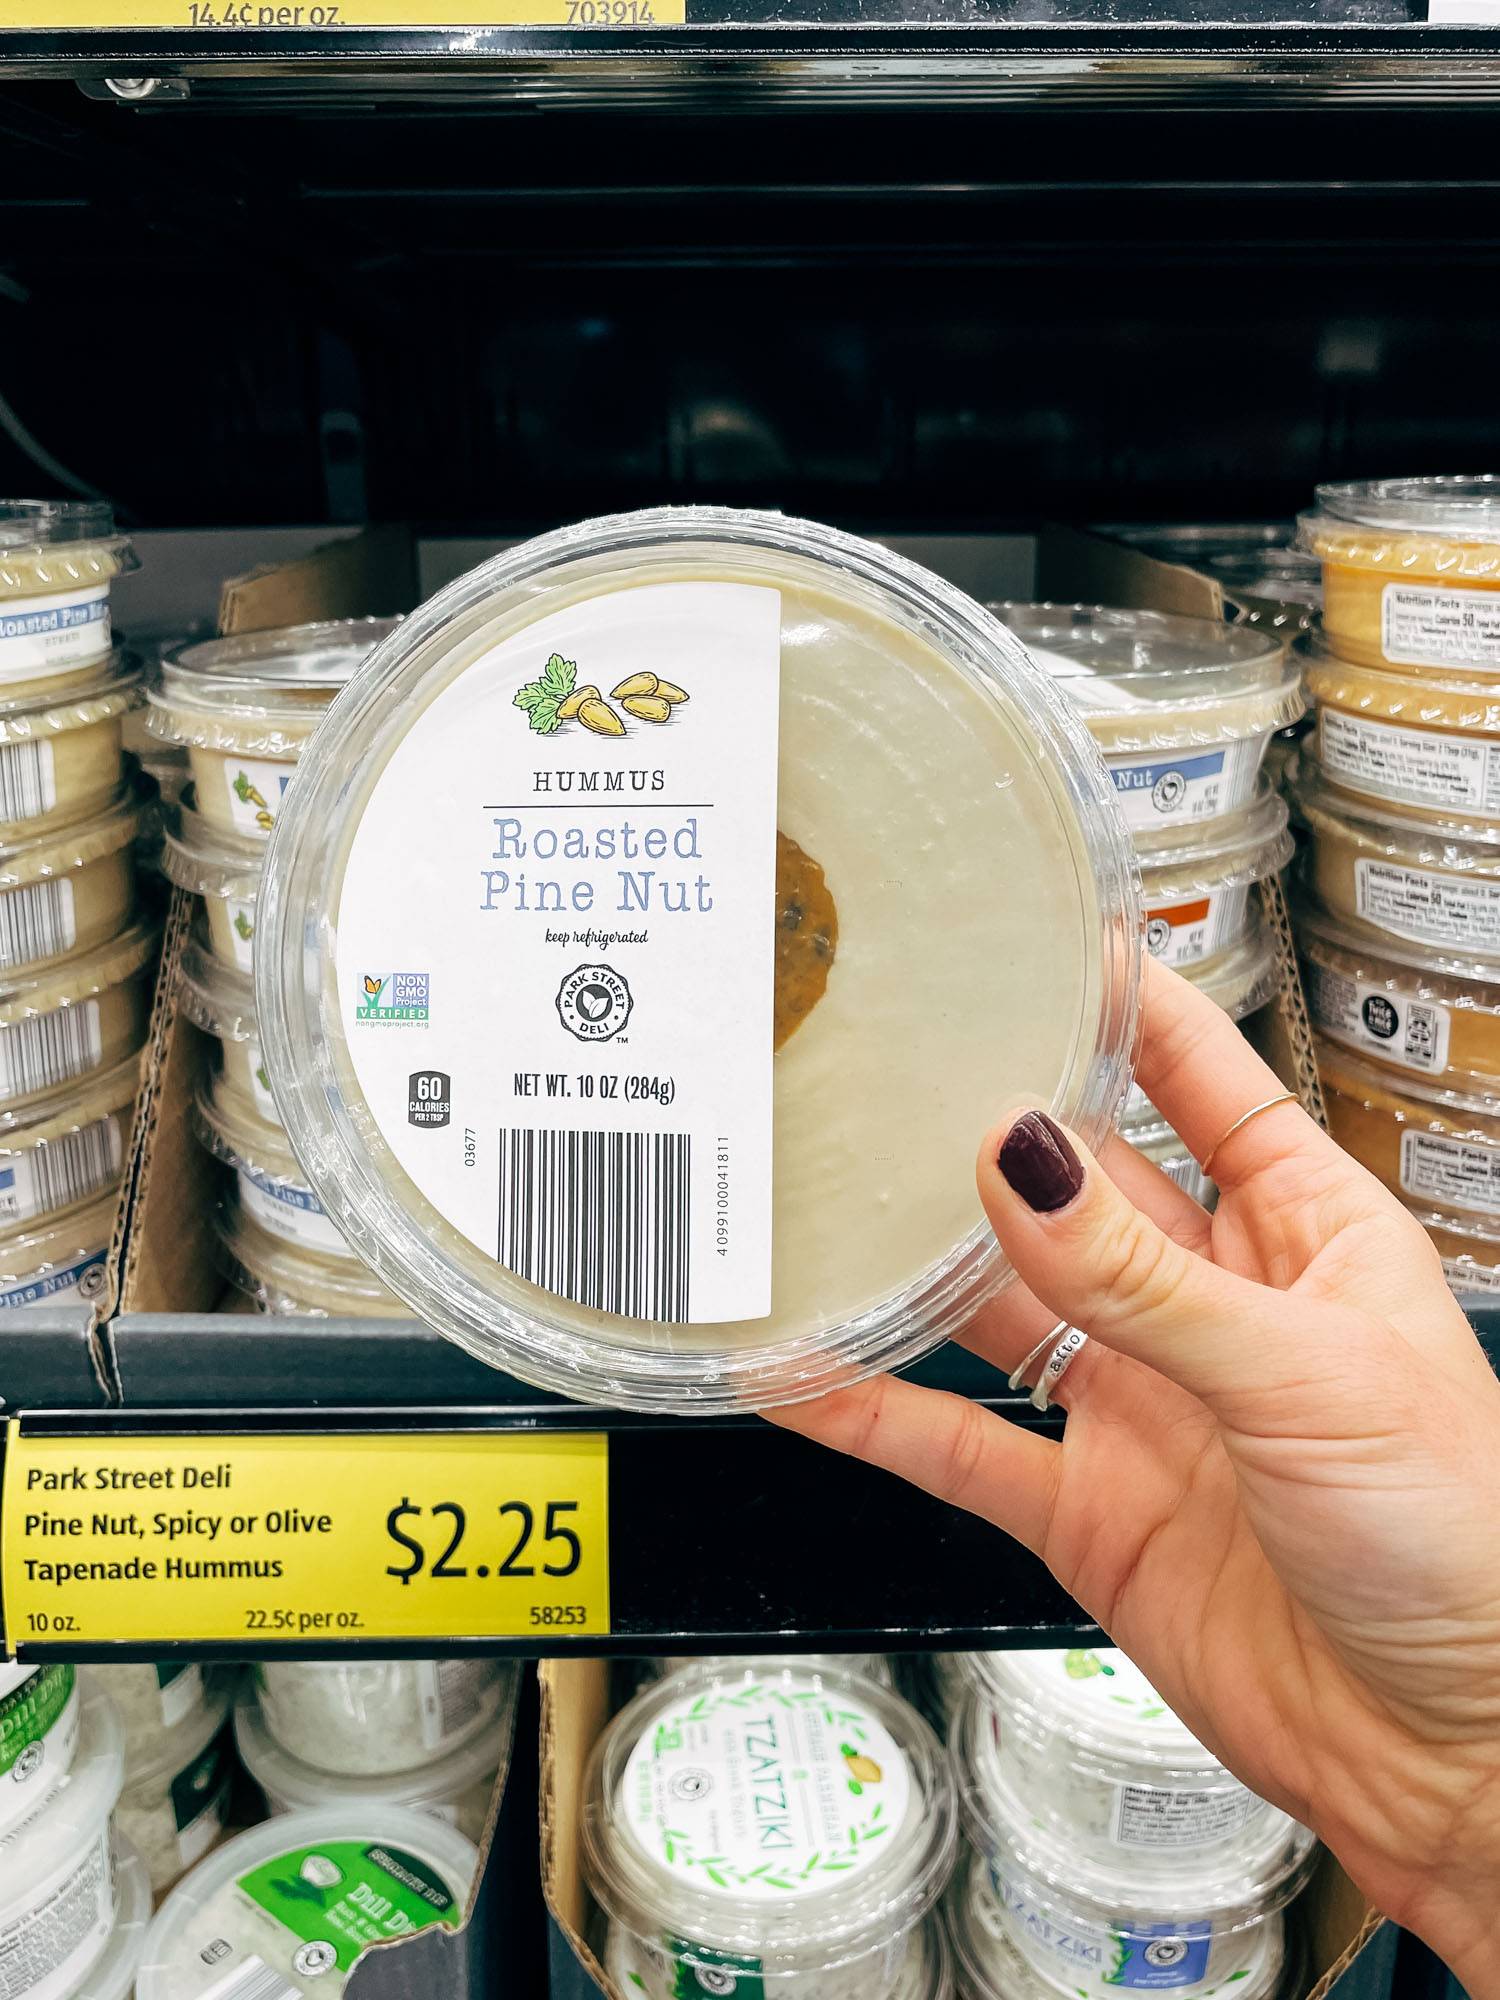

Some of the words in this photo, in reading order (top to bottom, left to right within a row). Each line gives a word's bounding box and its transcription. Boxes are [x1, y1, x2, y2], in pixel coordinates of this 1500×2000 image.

[188, 2, 253, 26] 14.4¢
[258, 6, 304, 26] per
[309, 6, 346, 25] oz.
[565, 0, 655, 25] 703914
[532, 769, 665, 792] HUMMUS
[1117, 769, 1153, 789] Nut
[492, 817, 703, 860] Roasted
[479, 870, 594, 912] Pine
[616, 871, 713, 913] Nut
[544, 927, 570, 948] keep
[572, 927, 649, 952] refrigerated
[396, 976, 426, 987] NON
[396, 986, 427, 997] GMO
[564, 973, 588, 1008] PARK
[591, 971, 625, 1010] STREET
[360, 1008, 426, 1018] VERIFIED
[396, 997, 427, 1008] Project
[356, 1021, 429, 1029] nongmoproject.org
[579, 1022, 609, 1034] DELI
[417, 1076, 442, 1101] 60
[514, 1073, 542, 1097] NET
[546, 1074, 572, 1098] WT.
[576, 1075, 595, 1099] 10
[599, 1075, 619, 1099] OZ
[623, 1075, 676, 1106] (284g)
[409, 1101, 450, 1113] CALORIES
[464, 1127, 477, 1167] 03677
[26, 1466, 88, 1491] Park
[94, 1467, 175, 1490] Street
[182, 1464, 232, 1489] Deli
[24, 1510, 84, 1536] Pine
[91, 1513, 146, 1540] Nut,
[152, 1510, 223, 1542] Spicy
[229, 1515, 259, 1535] or
[265, 1508, 333, 1534] Olive
[385, 1496, 583, 1587] $2.25
[23, 1556, 158, 1587] Tapenade
[165, 1557, 284, 1580] Hummus
[26, 1613, 49, 1632] 10
[52, 1615, 81, 1632] oz.
[245, 1609, 296, 1630] 22.5¢
[298, 1613, 334, 1634] per
[336, 1612, 365, 1629] oz.
[530, 1605, 587, 1626] 58253
[744, 1714, 793, 1849] TZATZIKI
